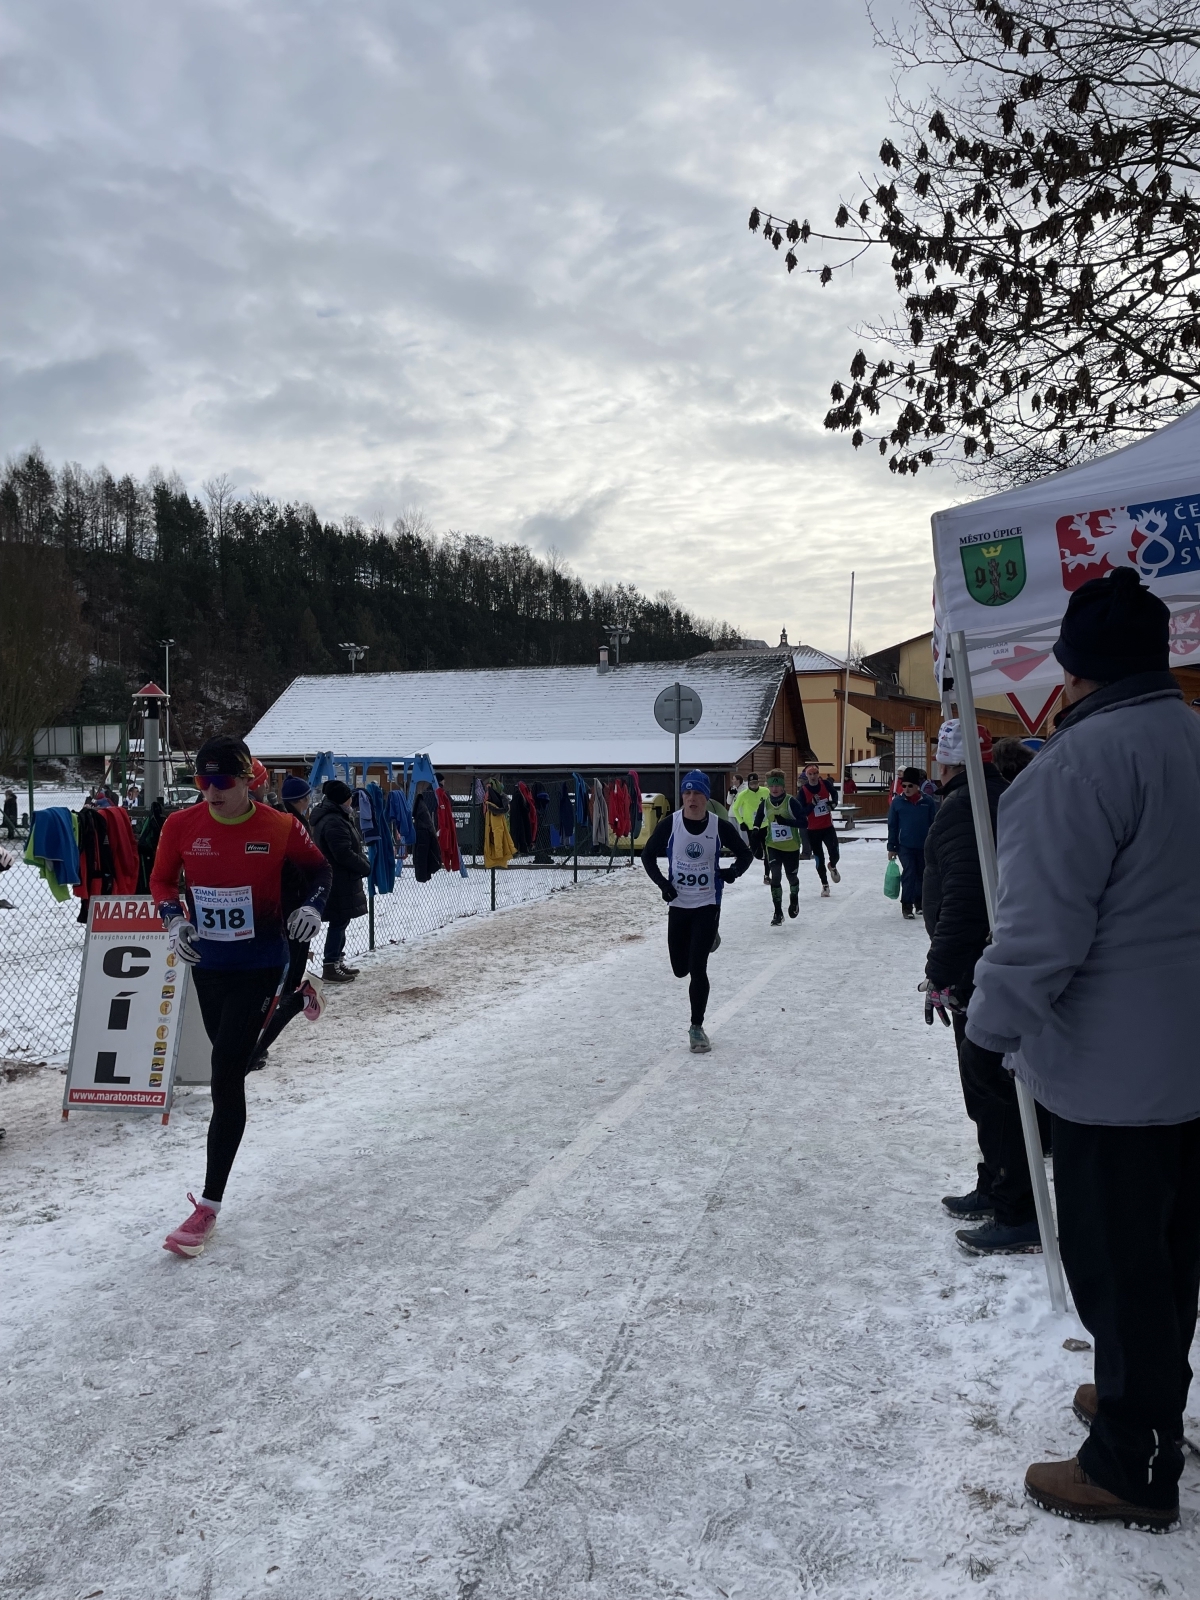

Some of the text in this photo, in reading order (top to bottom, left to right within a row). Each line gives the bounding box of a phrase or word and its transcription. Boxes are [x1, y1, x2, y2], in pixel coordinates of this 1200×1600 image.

[959, 526, 1023, 545] MĚSTO ÚPICE
[818, 804, 826, 813] 12
[775, 828, 787, 838] 50
[677, 872, 709, 887] 290
[193, 888, 217, 897] ZIMNÍ
[93, 901, 191, 921] MARATN
[202, 907, 246, 930] 318
[72, 1091, 163, 1103] www.maratonstav.cz
